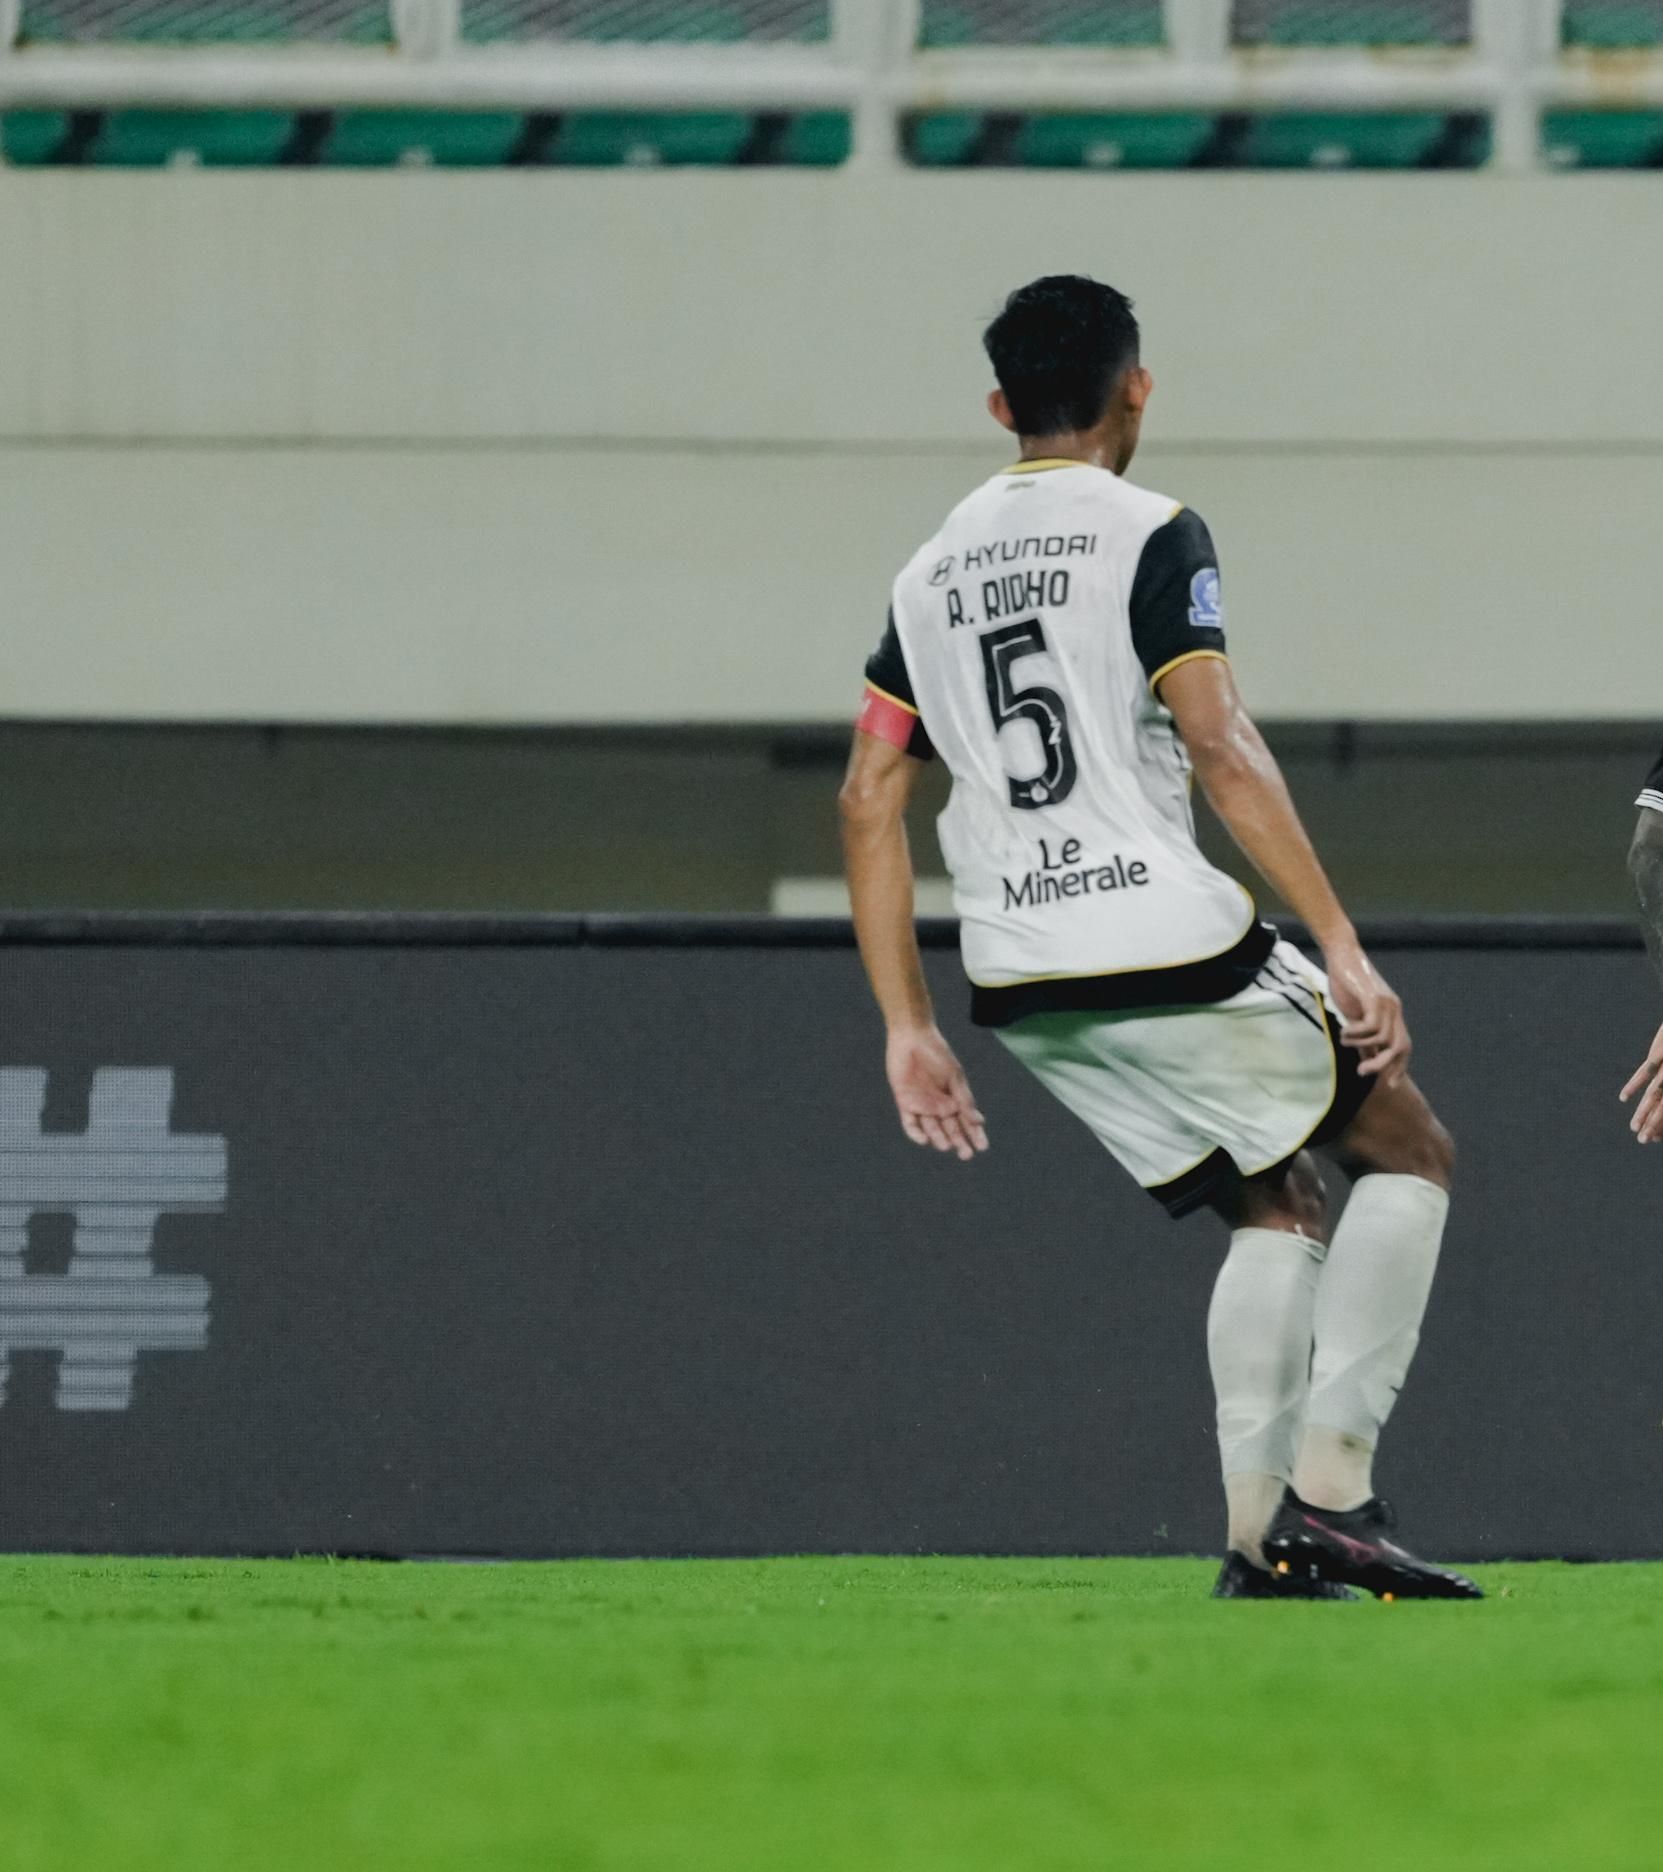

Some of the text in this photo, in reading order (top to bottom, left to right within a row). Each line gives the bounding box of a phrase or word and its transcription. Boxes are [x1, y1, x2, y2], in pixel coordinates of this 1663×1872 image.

[964, 534, 1097, 571] HYUNDAI
[948, 570, 1069, 628] R. RIDHO
[979, 617, 1077, 809] 5
[1003, 854, 1149, 911] Minerale
[1040, 838, 1082, 870] Le
